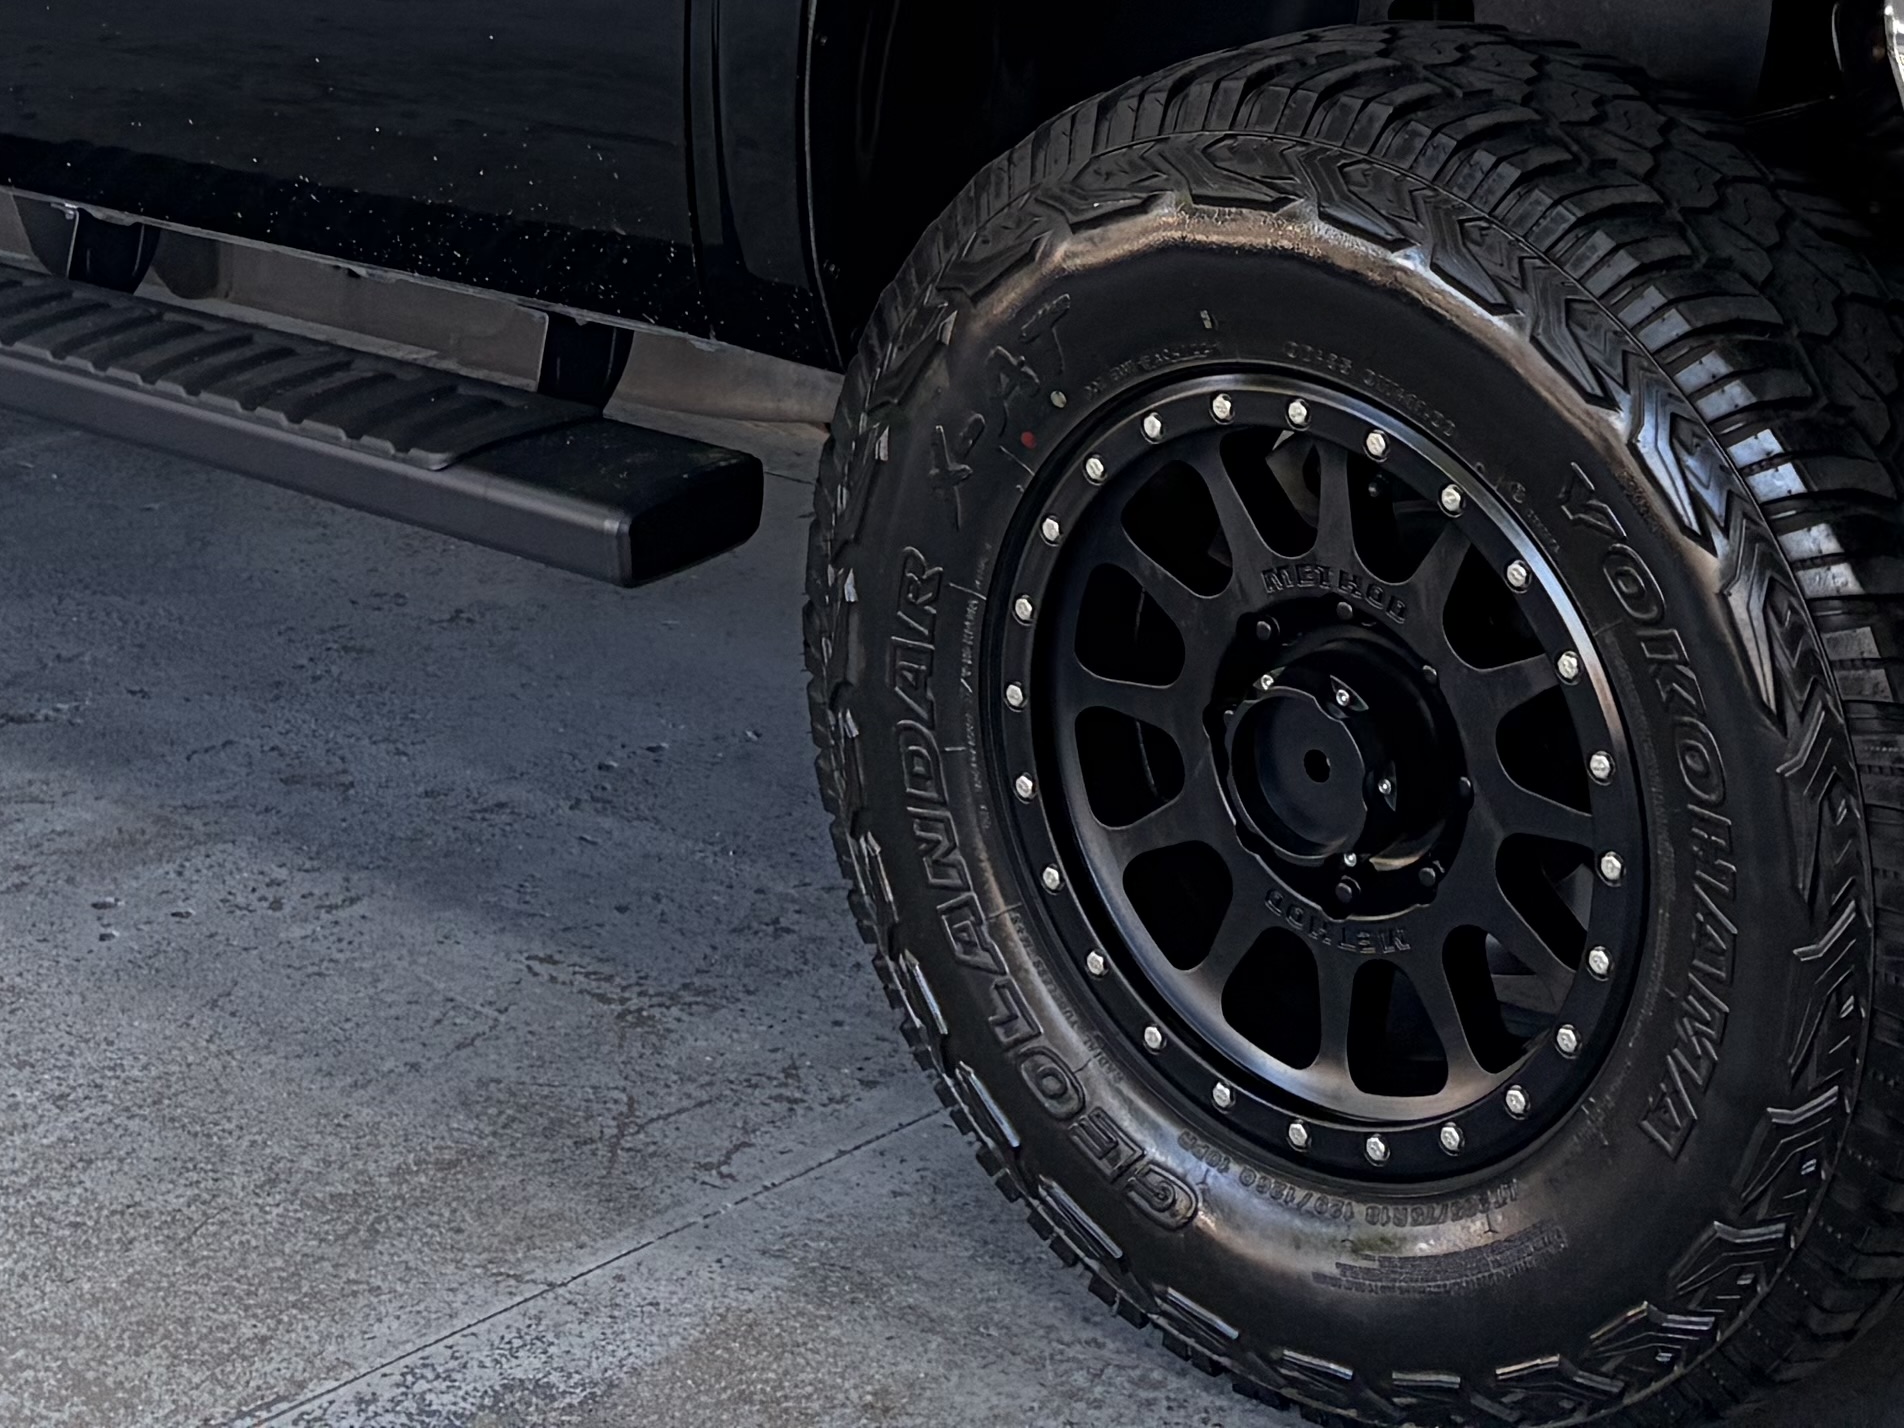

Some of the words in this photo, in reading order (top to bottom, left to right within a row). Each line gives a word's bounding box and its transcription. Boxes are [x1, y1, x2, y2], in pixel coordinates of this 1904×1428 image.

[1261, 564, 1408, 624] METHOD
[889, 544, 1200, 1231] GEOLANDAR
[1264, 888, 1411, 954] METHOD
[1558, 460, 1739, 1162] YOKOHAMA
